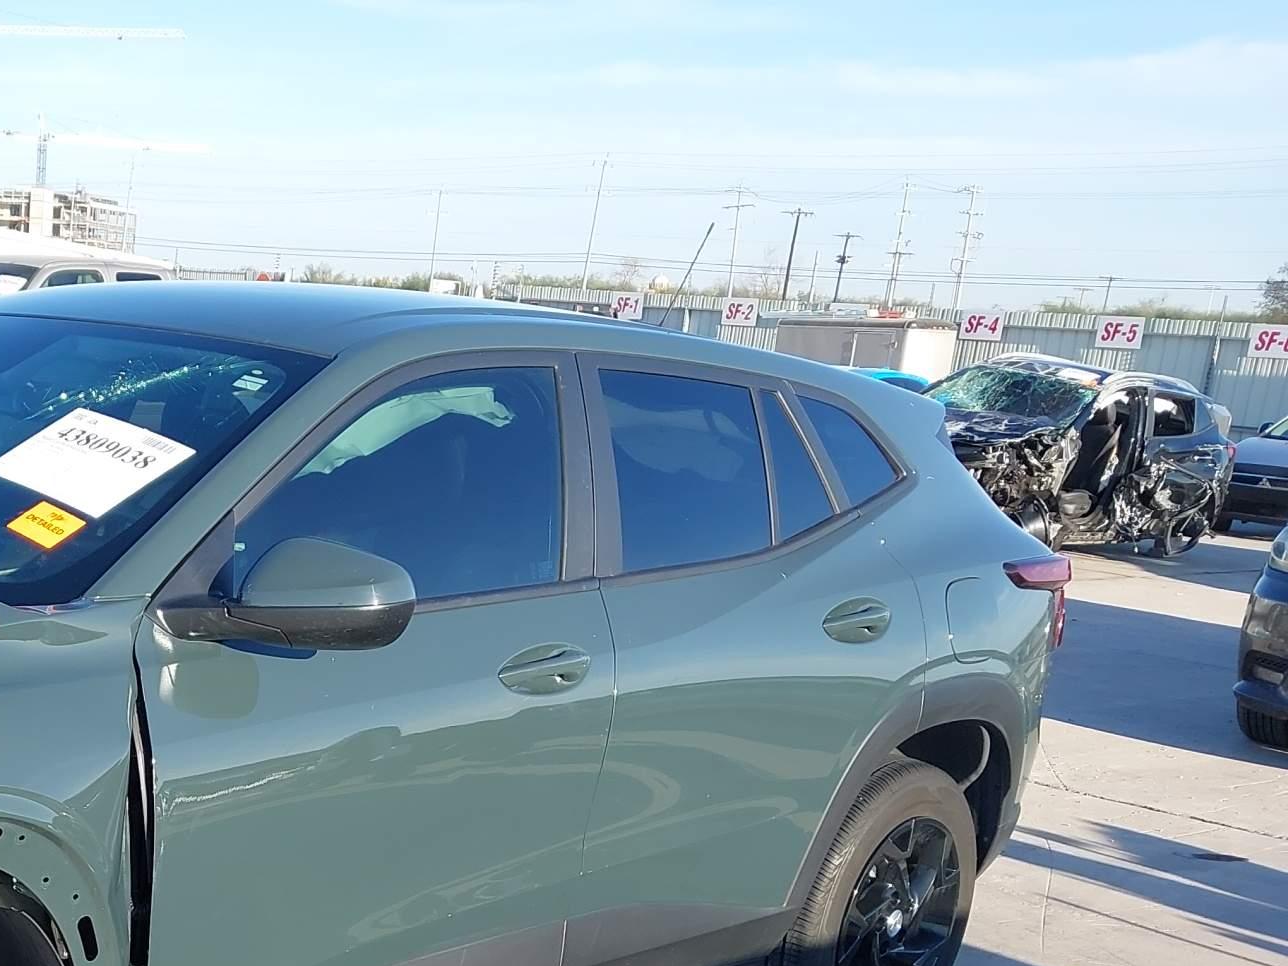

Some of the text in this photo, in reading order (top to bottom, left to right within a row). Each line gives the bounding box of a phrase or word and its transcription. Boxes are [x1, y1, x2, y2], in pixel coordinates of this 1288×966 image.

[616, 296, 639, 314] SF-1
[726, 303, 754, 320] SF-2
[965, 315, 1000, 334] SF-4
[1101, 322, 1139, 343] SF-5
[57, 427, 157, 469] 43809038
[25, 513, 65, 535] DETAILED
